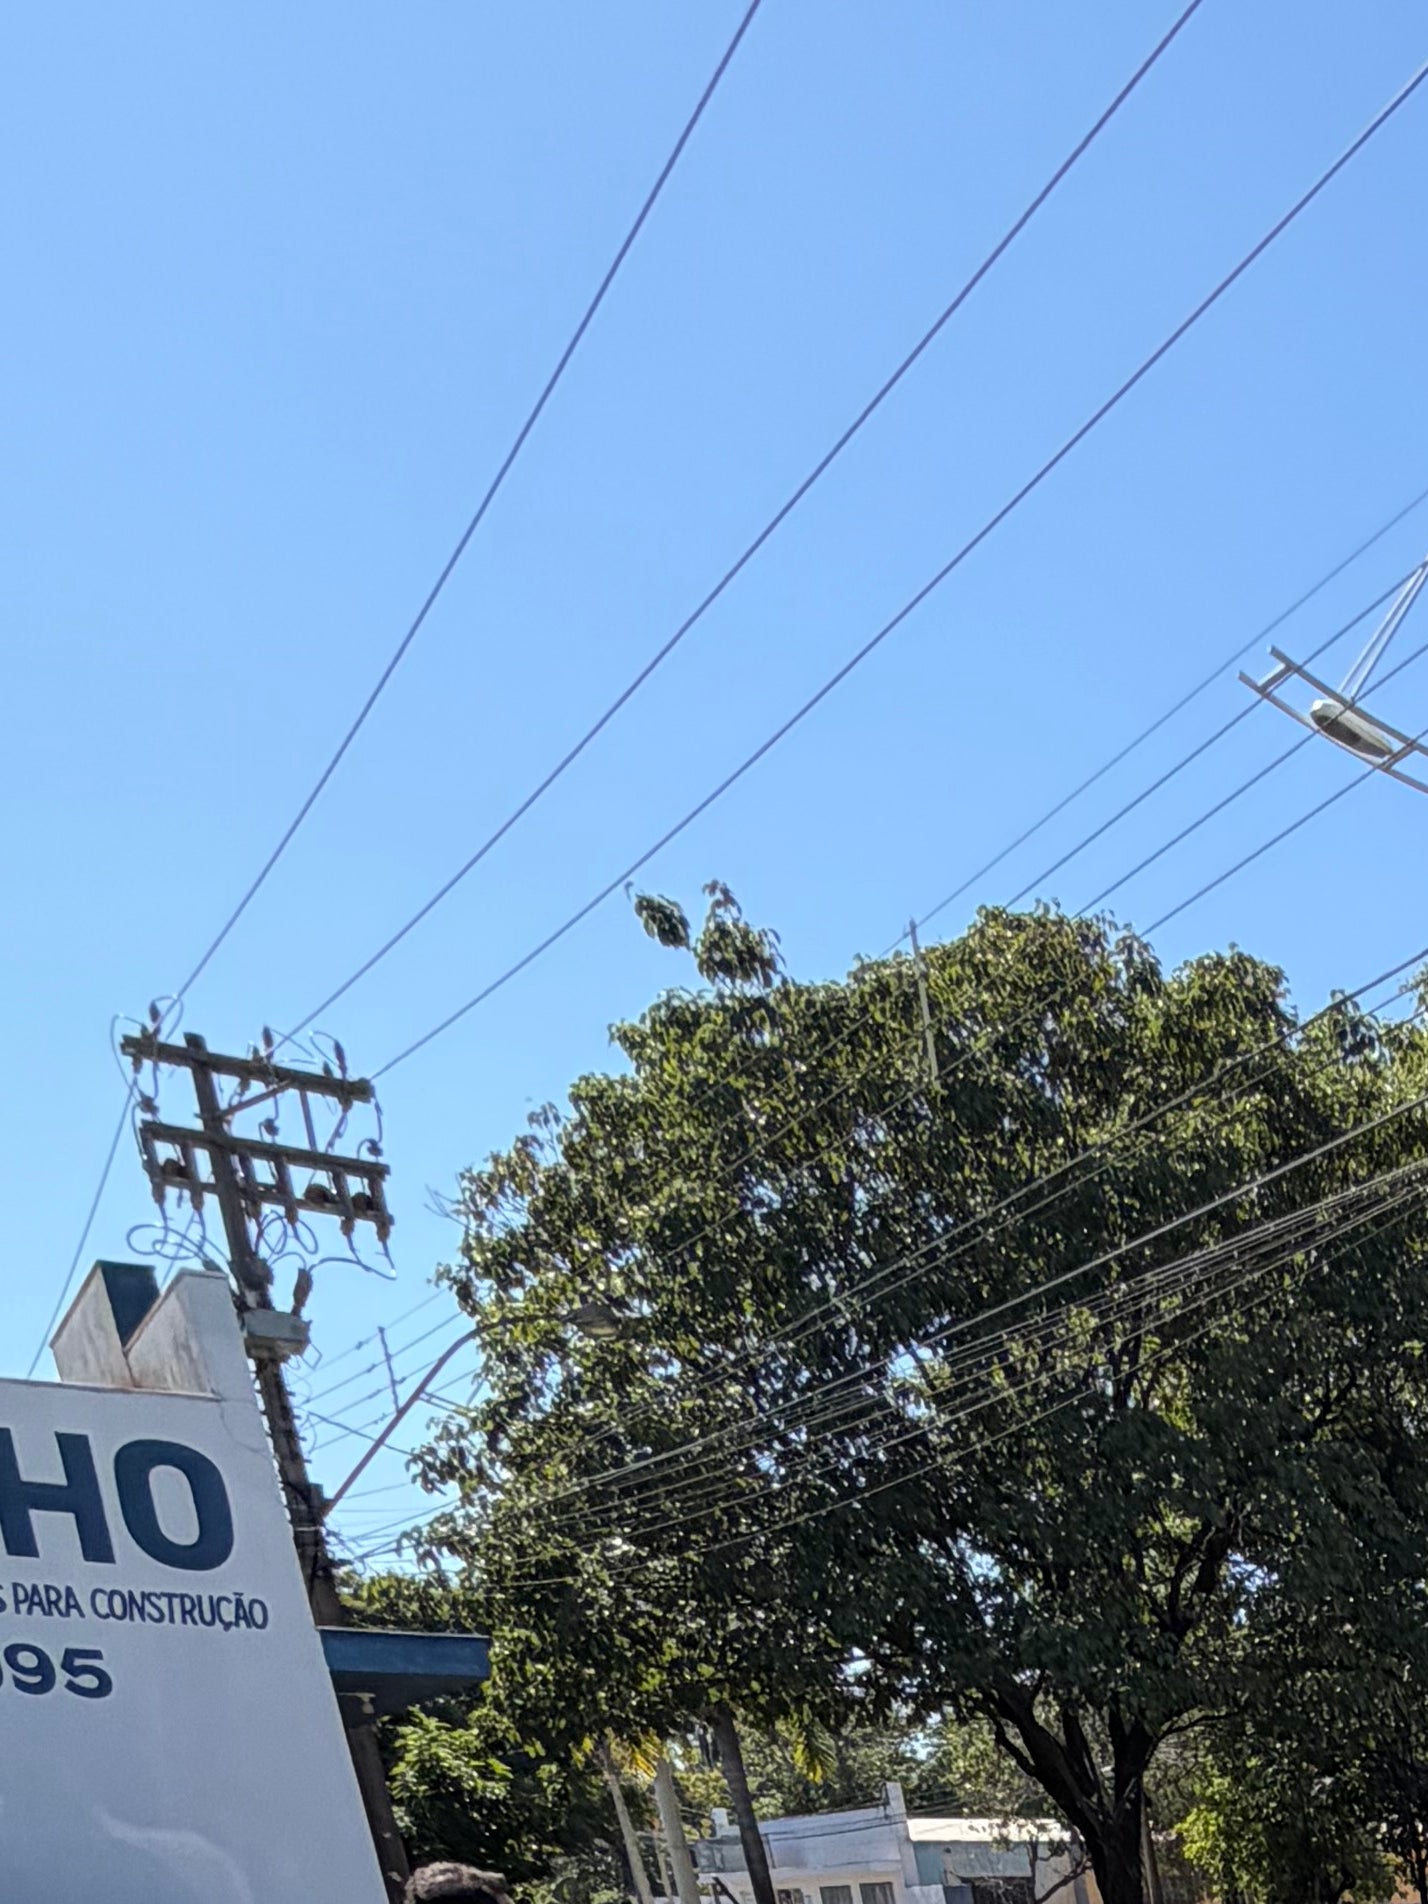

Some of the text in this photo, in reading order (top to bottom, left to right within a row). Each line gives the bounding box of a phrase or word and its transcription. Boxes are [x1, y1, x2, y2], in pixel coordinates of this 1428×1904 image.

[12, 1582, 86, 1619] PARA
[90, 1587, 269, 1632] CONSTRUÇÃO
[0, 1643, 113, 1699] 95
